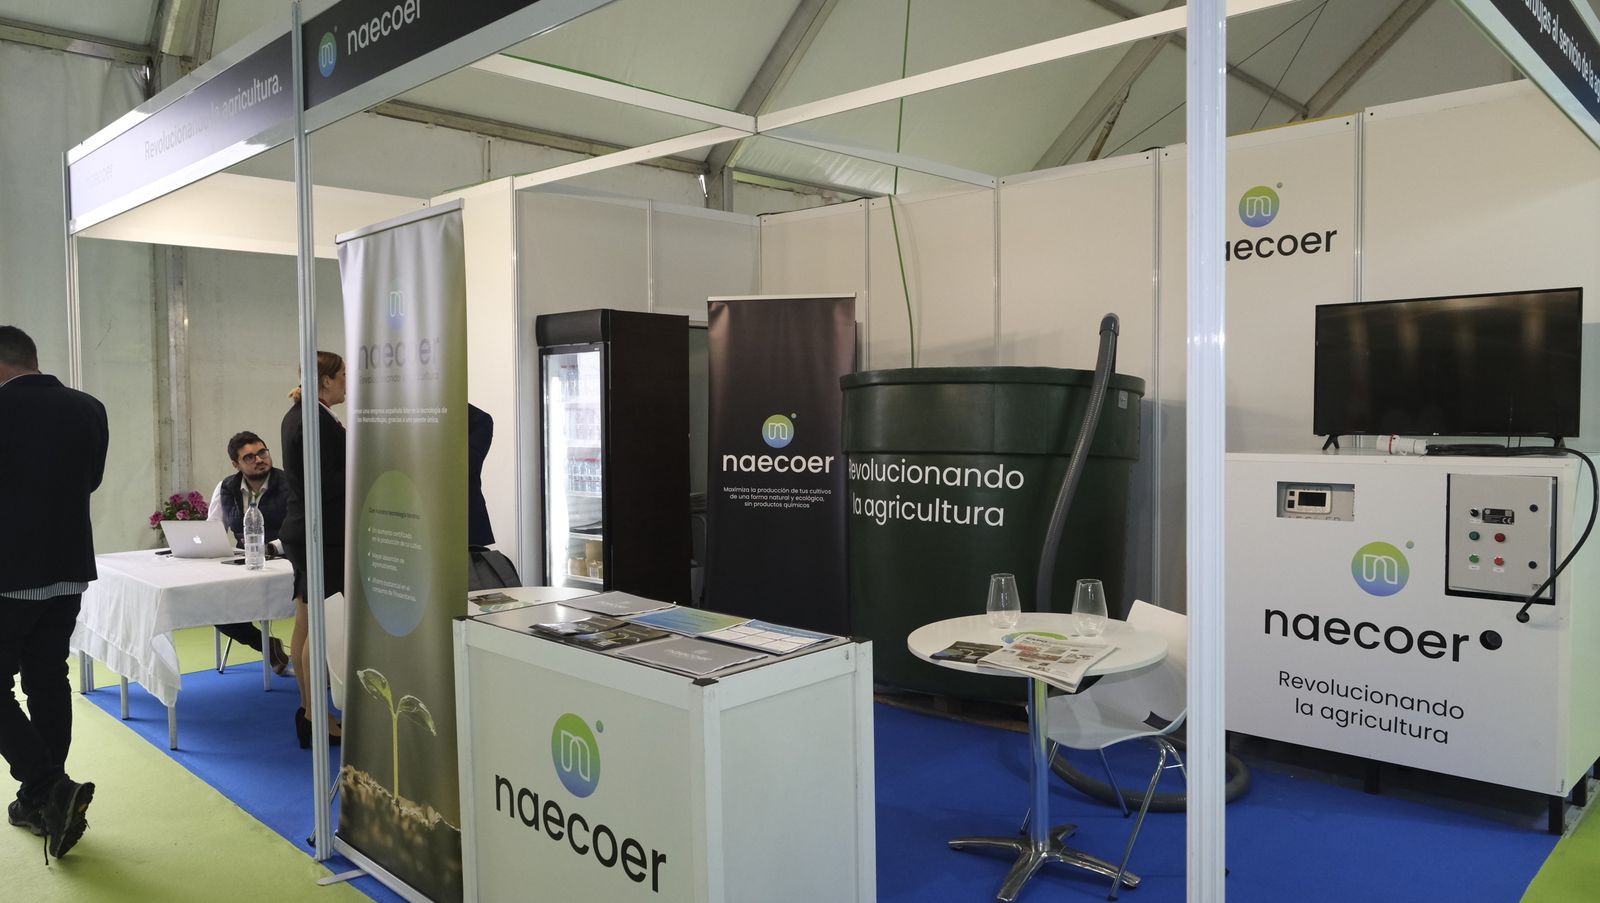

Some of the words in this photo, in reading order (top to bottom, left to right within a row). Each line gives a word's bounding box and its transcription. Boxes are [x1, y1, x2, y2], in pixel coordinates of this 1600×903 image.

[1559, 28, 1581, 72] servicio
[222, 73, 283, 121] agricultura.
[1225, 229, 1338, 262] ecoer
[722, 454, 834, 474] naecoer
[757, 487, 790, 495] producción
[852, 492, 862, 515] la
[864, 494, 1005, 526] agricultura
[1264, 608, 1470, 662] naecoer
[1279, 670, 1465, 720] Revolucionando
[1295, 697, 1314, 717] la
[1320, 708, 1449, 745] agricultura
[494, 773, 667, 893] naecoer
